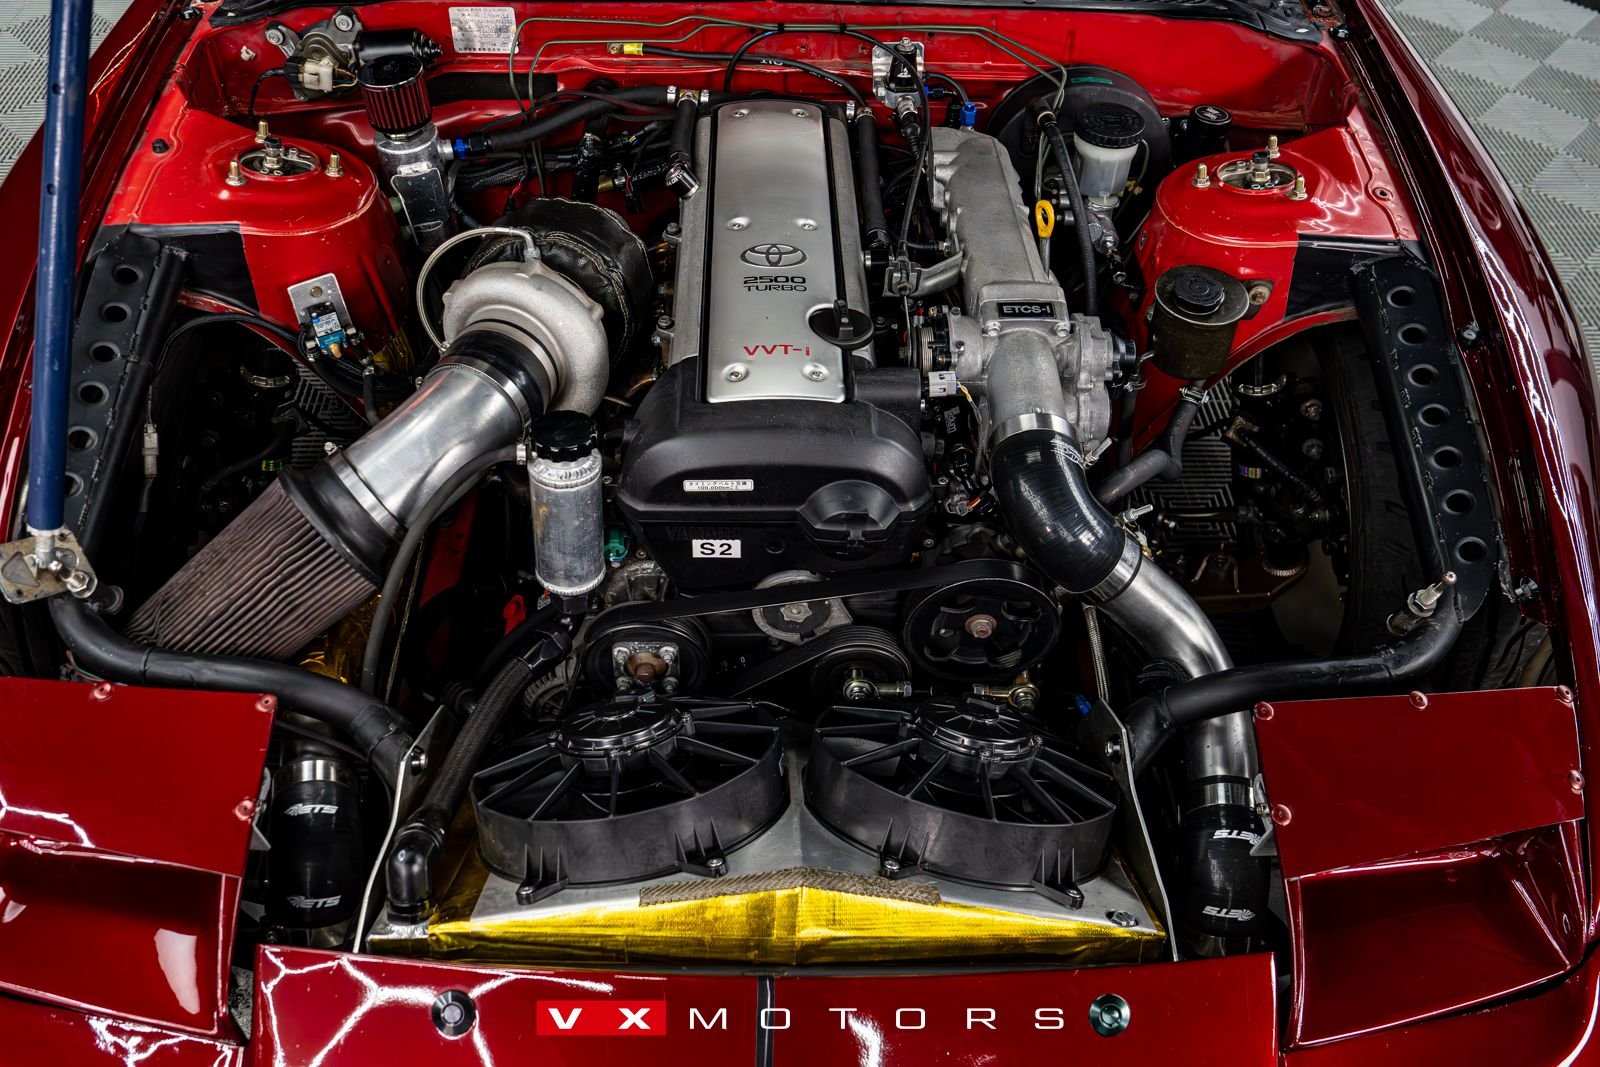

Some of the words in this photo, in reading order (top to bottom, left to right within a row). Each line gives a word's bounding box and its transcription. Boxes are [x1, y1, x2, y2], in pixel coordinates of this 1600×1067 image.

[743, 275, 807, 285] 2500
[743, 284, 808, 292] TURBO
[743, 344, 811, 357] VVT-i
[700, 542, 733, 556] S2
[300, 803, 339, 814] ETS
[1213, 829, 1256, 841] ETS
[301, 895, 342, 908] ETS
[1202, 905, 1244, 919] ETS
